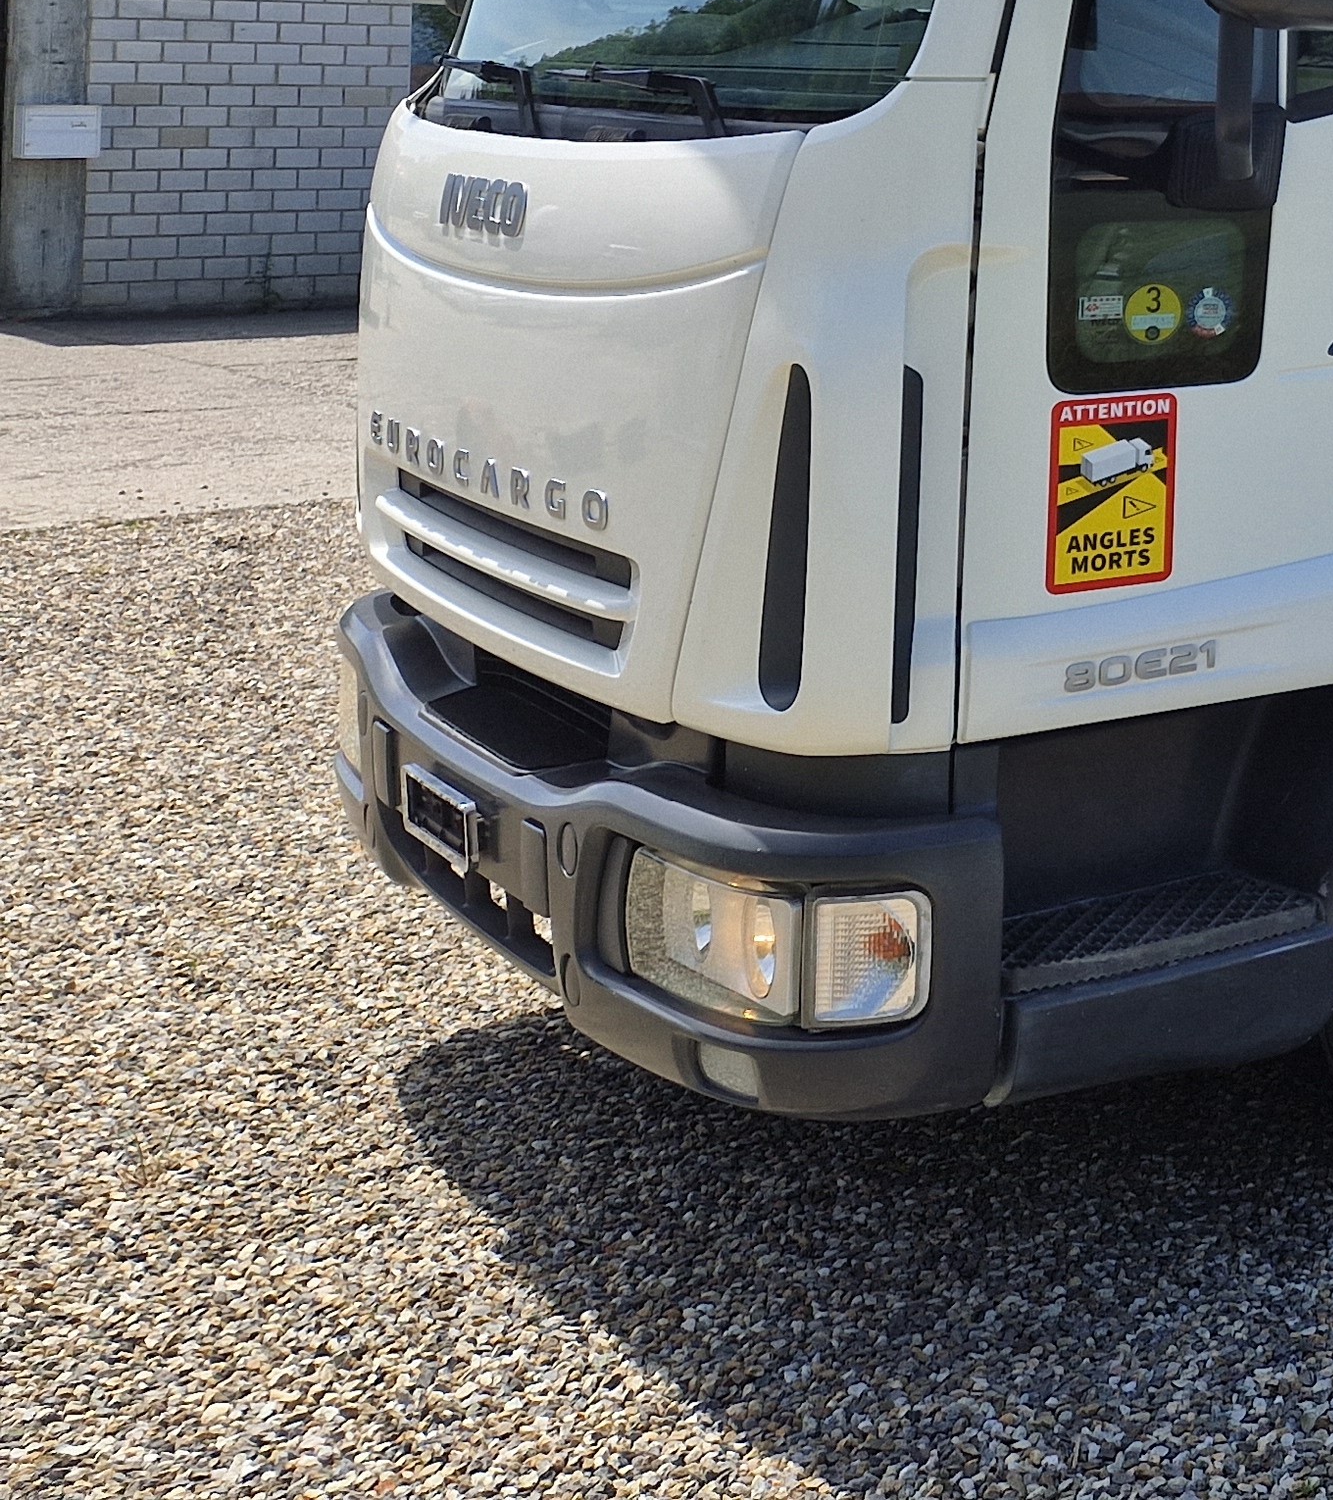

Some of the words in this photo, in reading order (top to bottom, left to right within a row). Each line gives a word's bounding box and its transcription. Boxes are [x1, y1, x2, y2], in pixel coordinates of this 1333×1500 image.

[439, 172, 529, 238] IVECO
[1145, 286, 1161, 313] 3
[1059, 398, 1171, 422] ATTENTION
[370, 410, 609, 531] EUROCARGO
[1066, 526, 1156, 555] ANGLES
[1070, 548, 1151, 575] MORTS
[1064, 639, 1217, 693] 80E21
